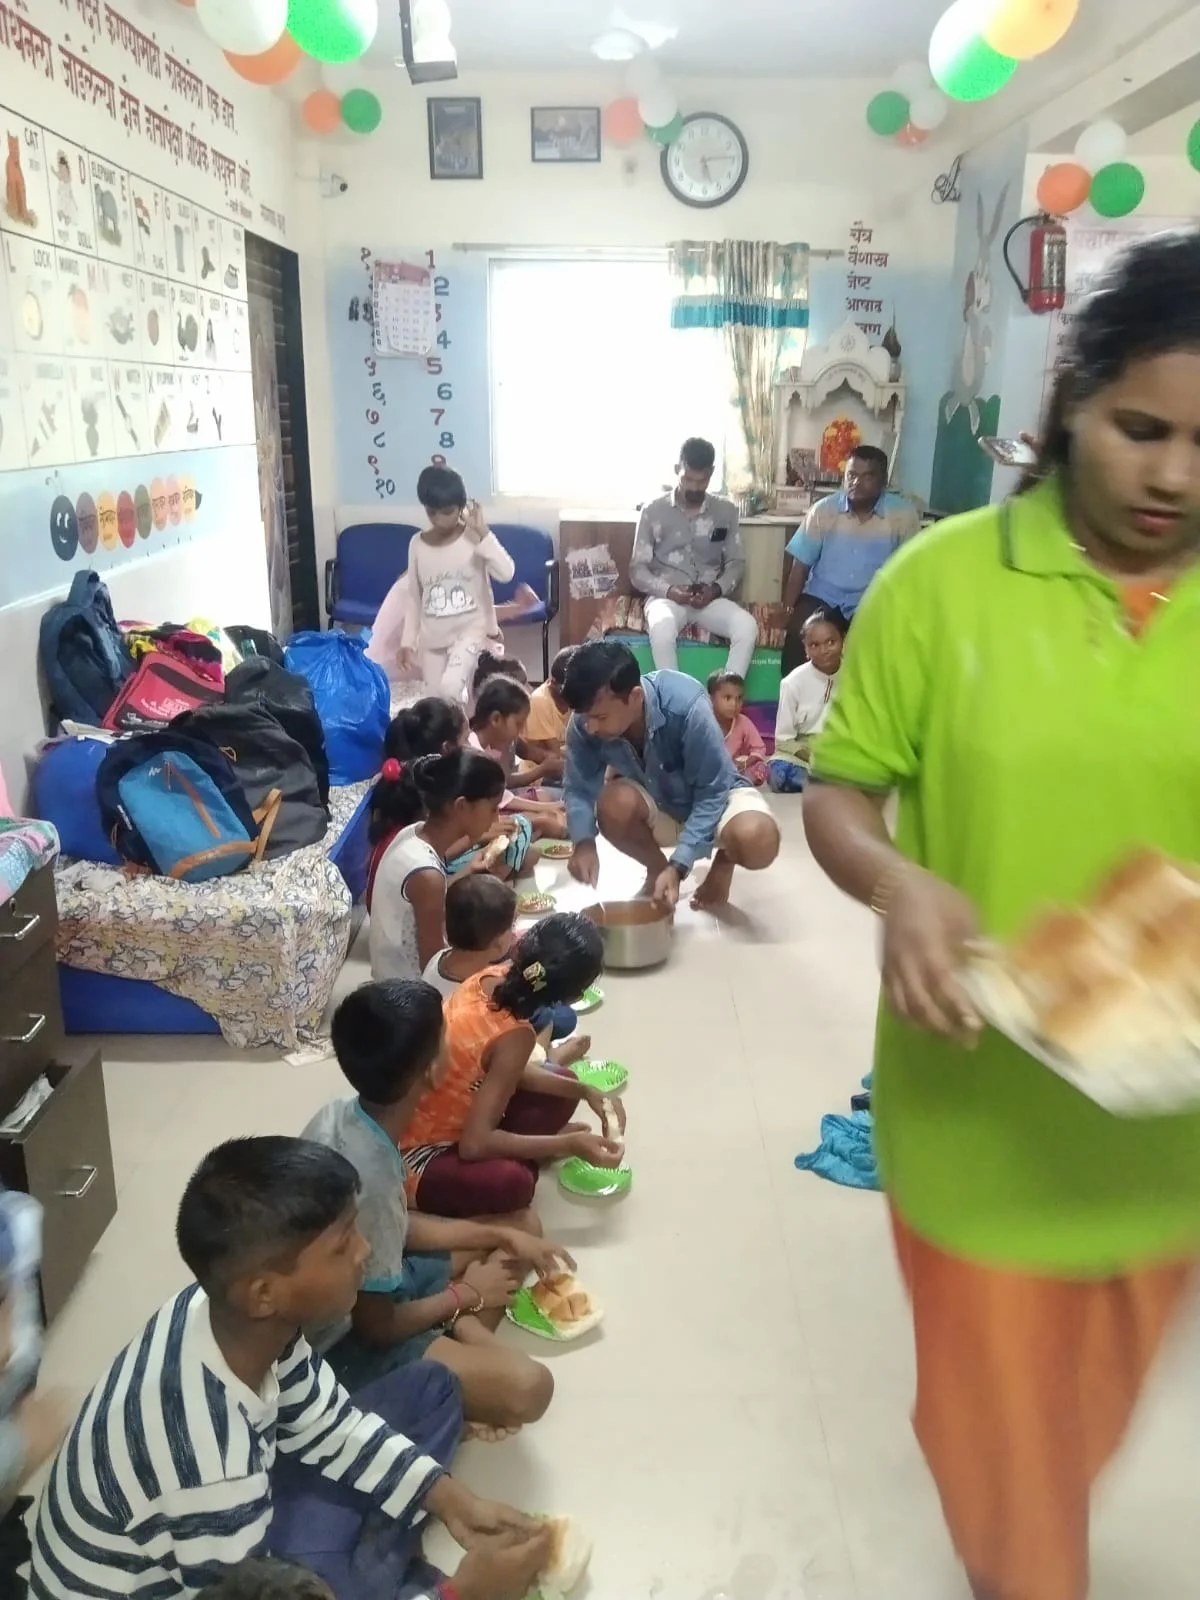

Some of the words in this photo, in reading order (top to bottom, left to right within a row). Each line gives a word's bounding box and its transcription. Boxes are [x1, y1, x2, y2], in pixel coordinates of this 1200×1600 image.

[25, 127, 38, 150] CAT
[849, 220, 873, 244] चैत्र
[425, 249, 436, 269] 1
[848, 245, 889, 268] वैशाख
[434, 276, 450, 297] 2
[437, 330, 452, 349] 4
[427, 357, 443, 375] 5
[437, 383, 452, 400] 6
[366, 409, 379, 425] ७
[430, 408, 445, 425] 7
[439, 432, 455, 448] 8
